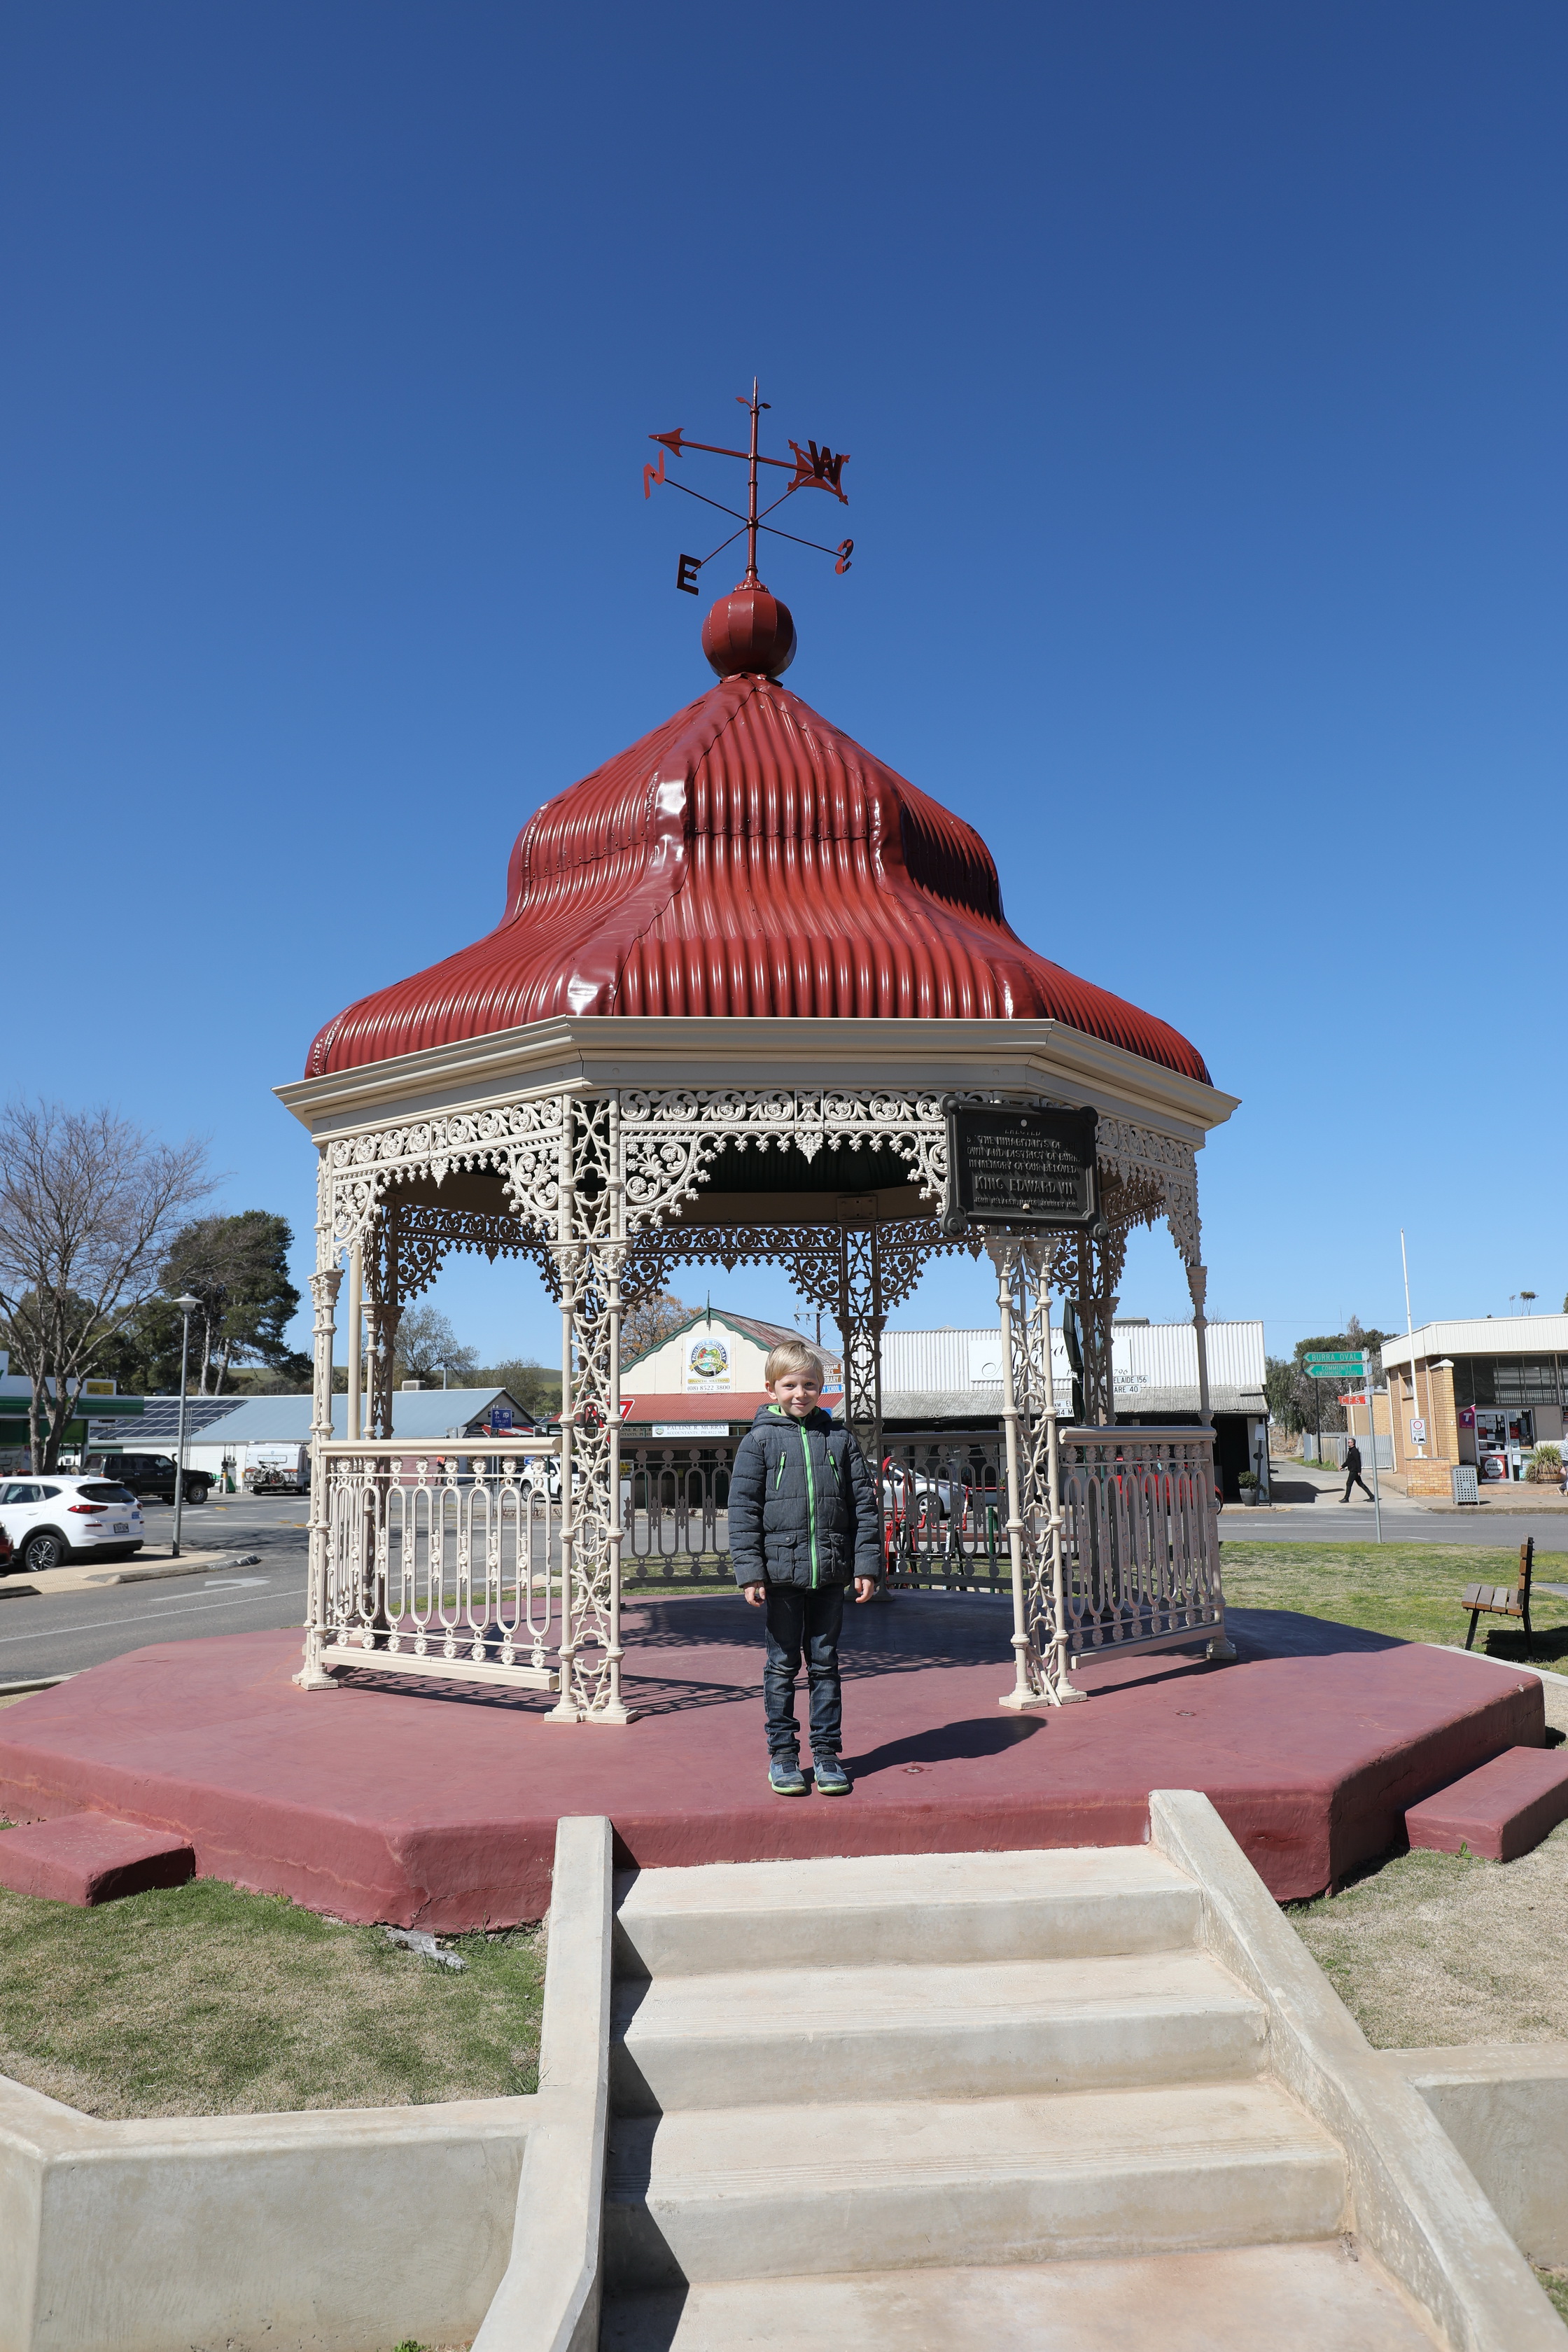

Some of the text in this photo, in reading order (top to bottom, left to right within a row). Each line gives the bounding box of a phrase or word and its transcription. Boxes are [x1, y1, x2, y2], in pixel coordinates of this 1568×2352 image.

[808, 440, 841, 485] W
[643, 449, 664, 500] N
[676, 554, 701, 596] E
[966, 1134, 976, 1143] B
[979, 1136, 994, 1145] THE
[996, 1136, 1050, 1149] INHABITANTS
[1052, 1140, 1062, 1149] OF
[963, 1146, 1082, 1162] OWN AND DISTRICT OF BURR
[969, 1159, 1077, 1174] IN MEMORY OF OUR BELOVED
[974, 1175, 1075, 1195] KING EDWARD VII.
[692, 1341, 706, 1361] PAULINE
[712, 1340, 727, 1361] MURRAY
[693, 1358, 725, 1366] ACCOUNTANTS
[1463, 1413, 1472, 1422] T
